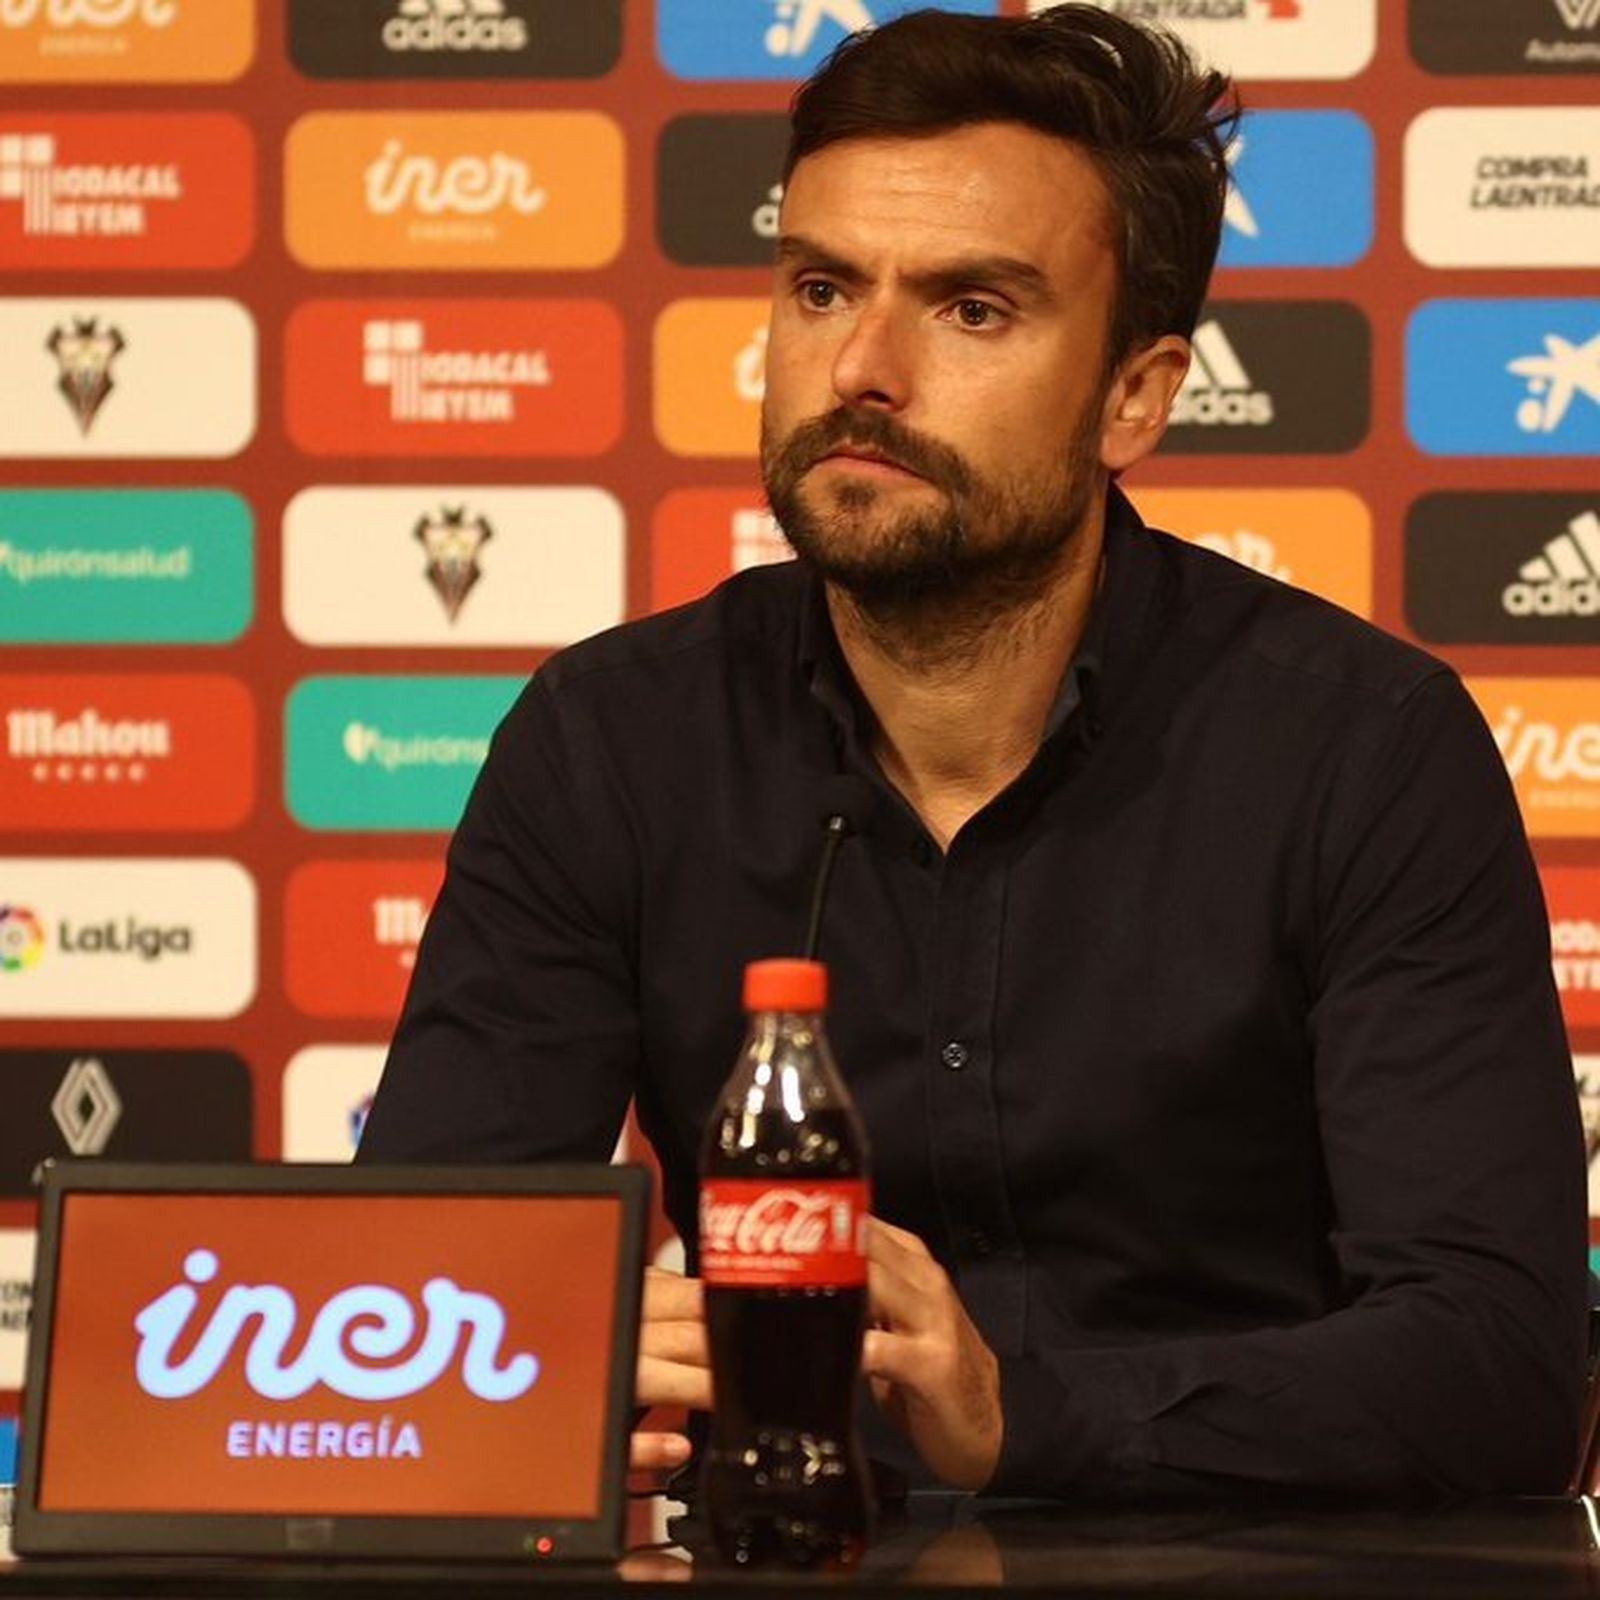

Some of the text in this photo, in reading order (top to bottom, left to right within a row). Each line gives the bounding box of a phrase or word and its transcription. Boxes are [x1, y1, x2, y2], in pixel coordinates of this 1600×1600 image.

[382, 17, 528, 51] adidas
[363, 138, 546, 215] iner
[1477, 156, 1587, 180] COMPRA
[7, 706, 171, 758] Mahou
[58, 917, 193, 960] LaLiga
[134, 1249, 539, 1402] iner
[226, 1415, 423, 1459] ENERGÍA
